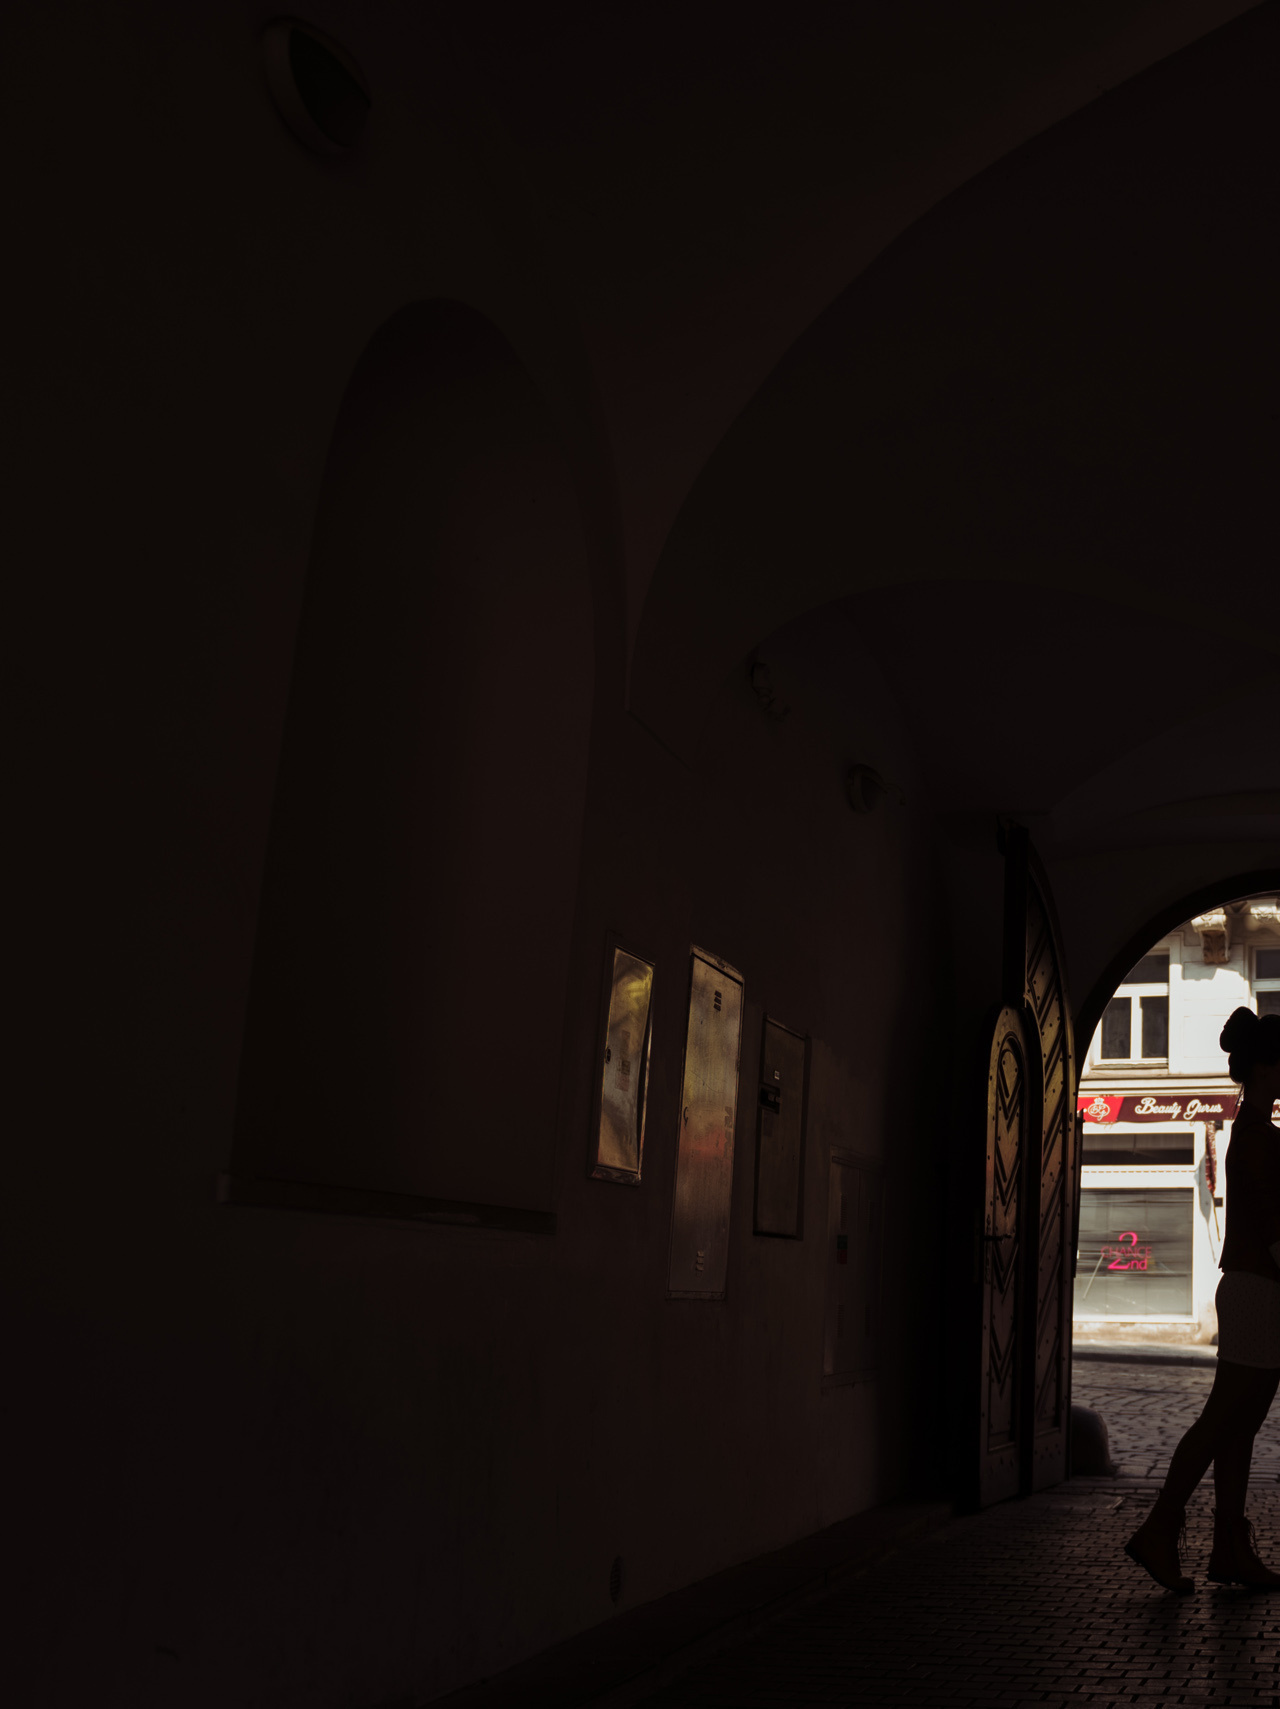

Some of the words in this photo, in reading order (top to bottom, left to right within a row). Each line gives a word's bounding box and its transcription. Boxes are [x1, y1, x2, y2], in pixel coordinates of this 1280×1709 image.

[1134, 1097, 1182, 1119] Beauty
[1183, 1098, 1223, 1120] Gurus
[1100, 1246, 1152, 1259] CHANCE
